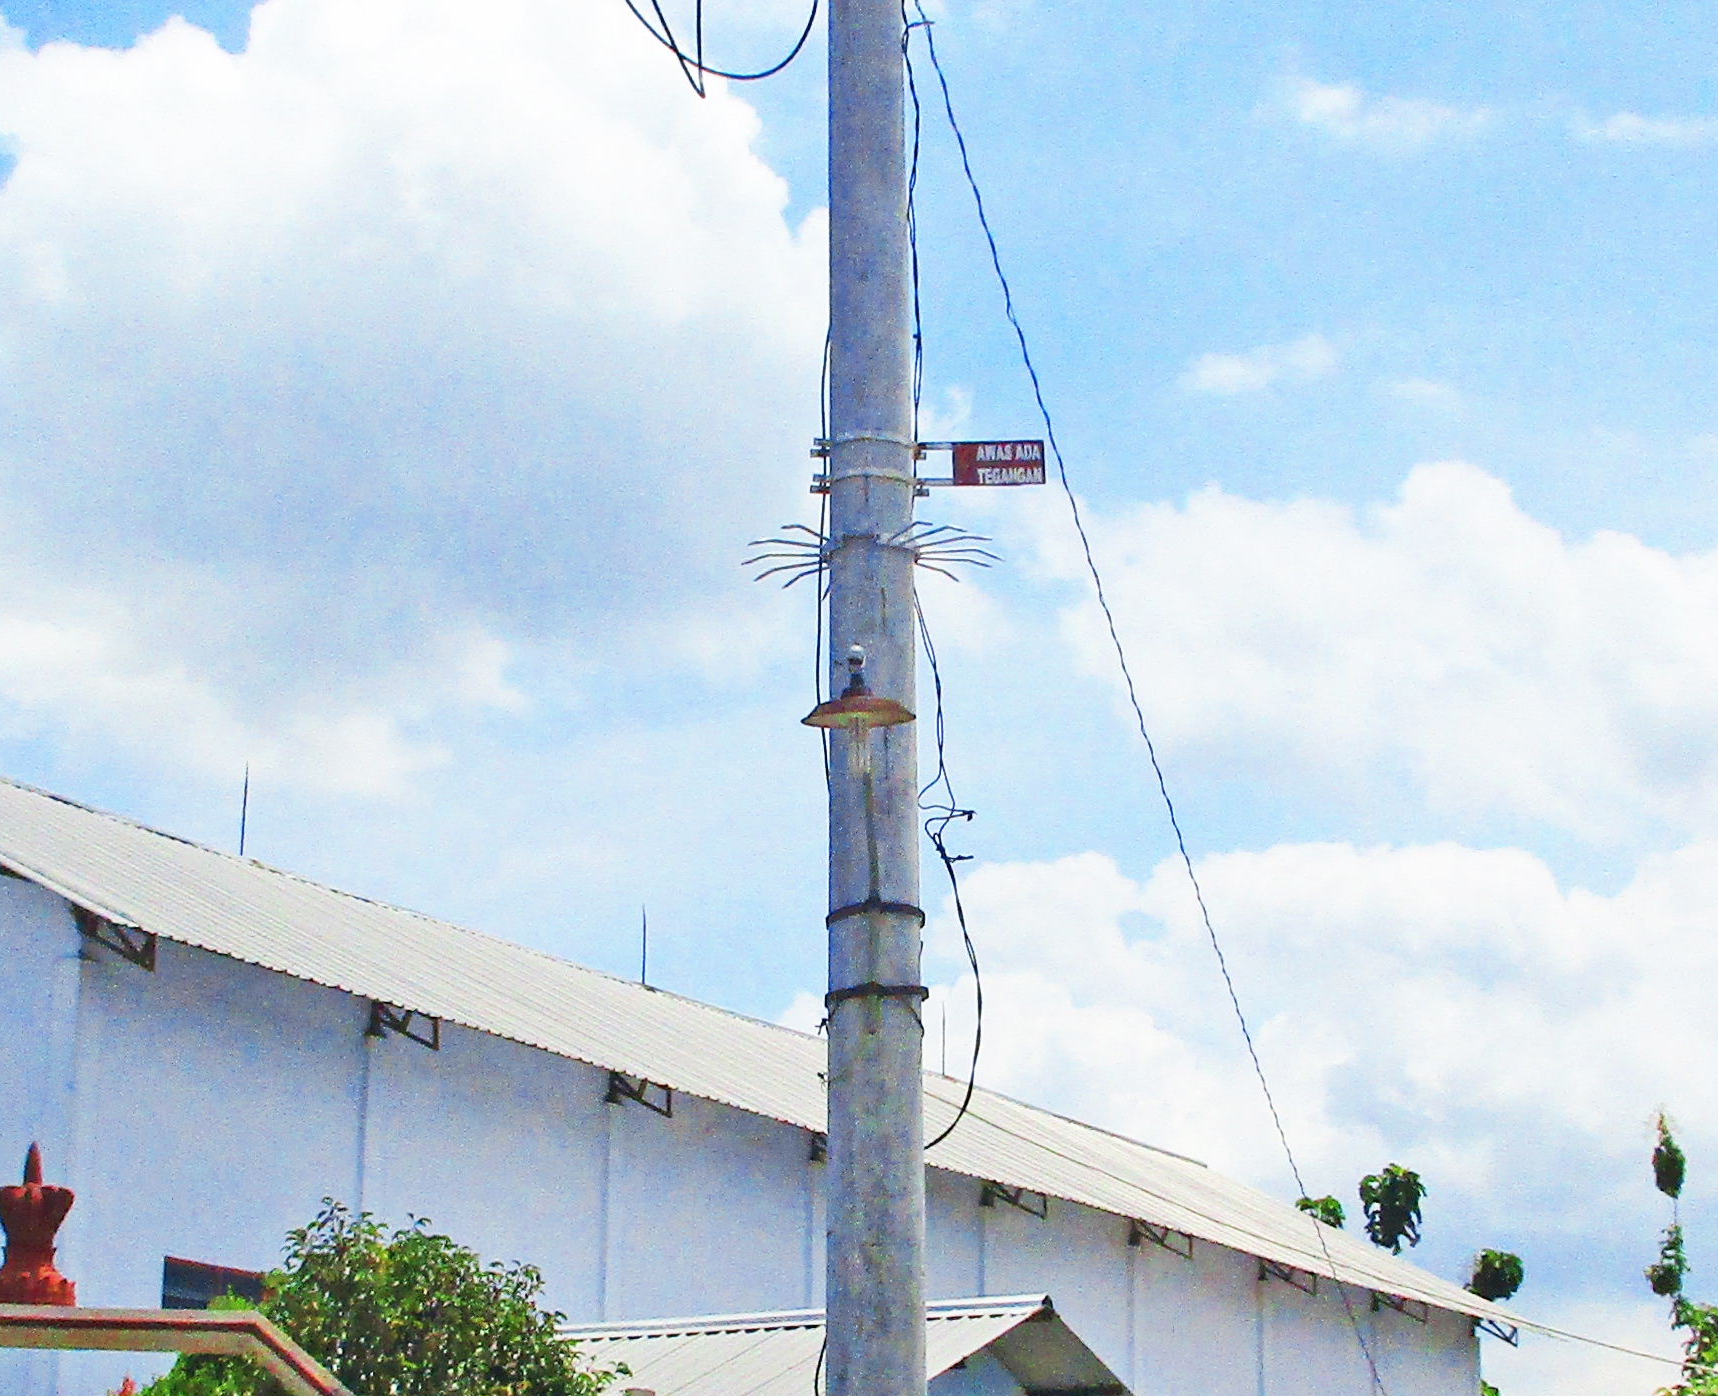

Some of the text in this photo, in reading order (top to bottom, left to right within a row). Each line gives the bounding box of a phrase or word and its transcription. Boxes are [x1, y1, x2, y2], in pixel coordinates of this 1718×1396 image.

[976, 444, 1040, 460] AWAS ADA
[977, 467, 1042, 484] TEGANGAN
